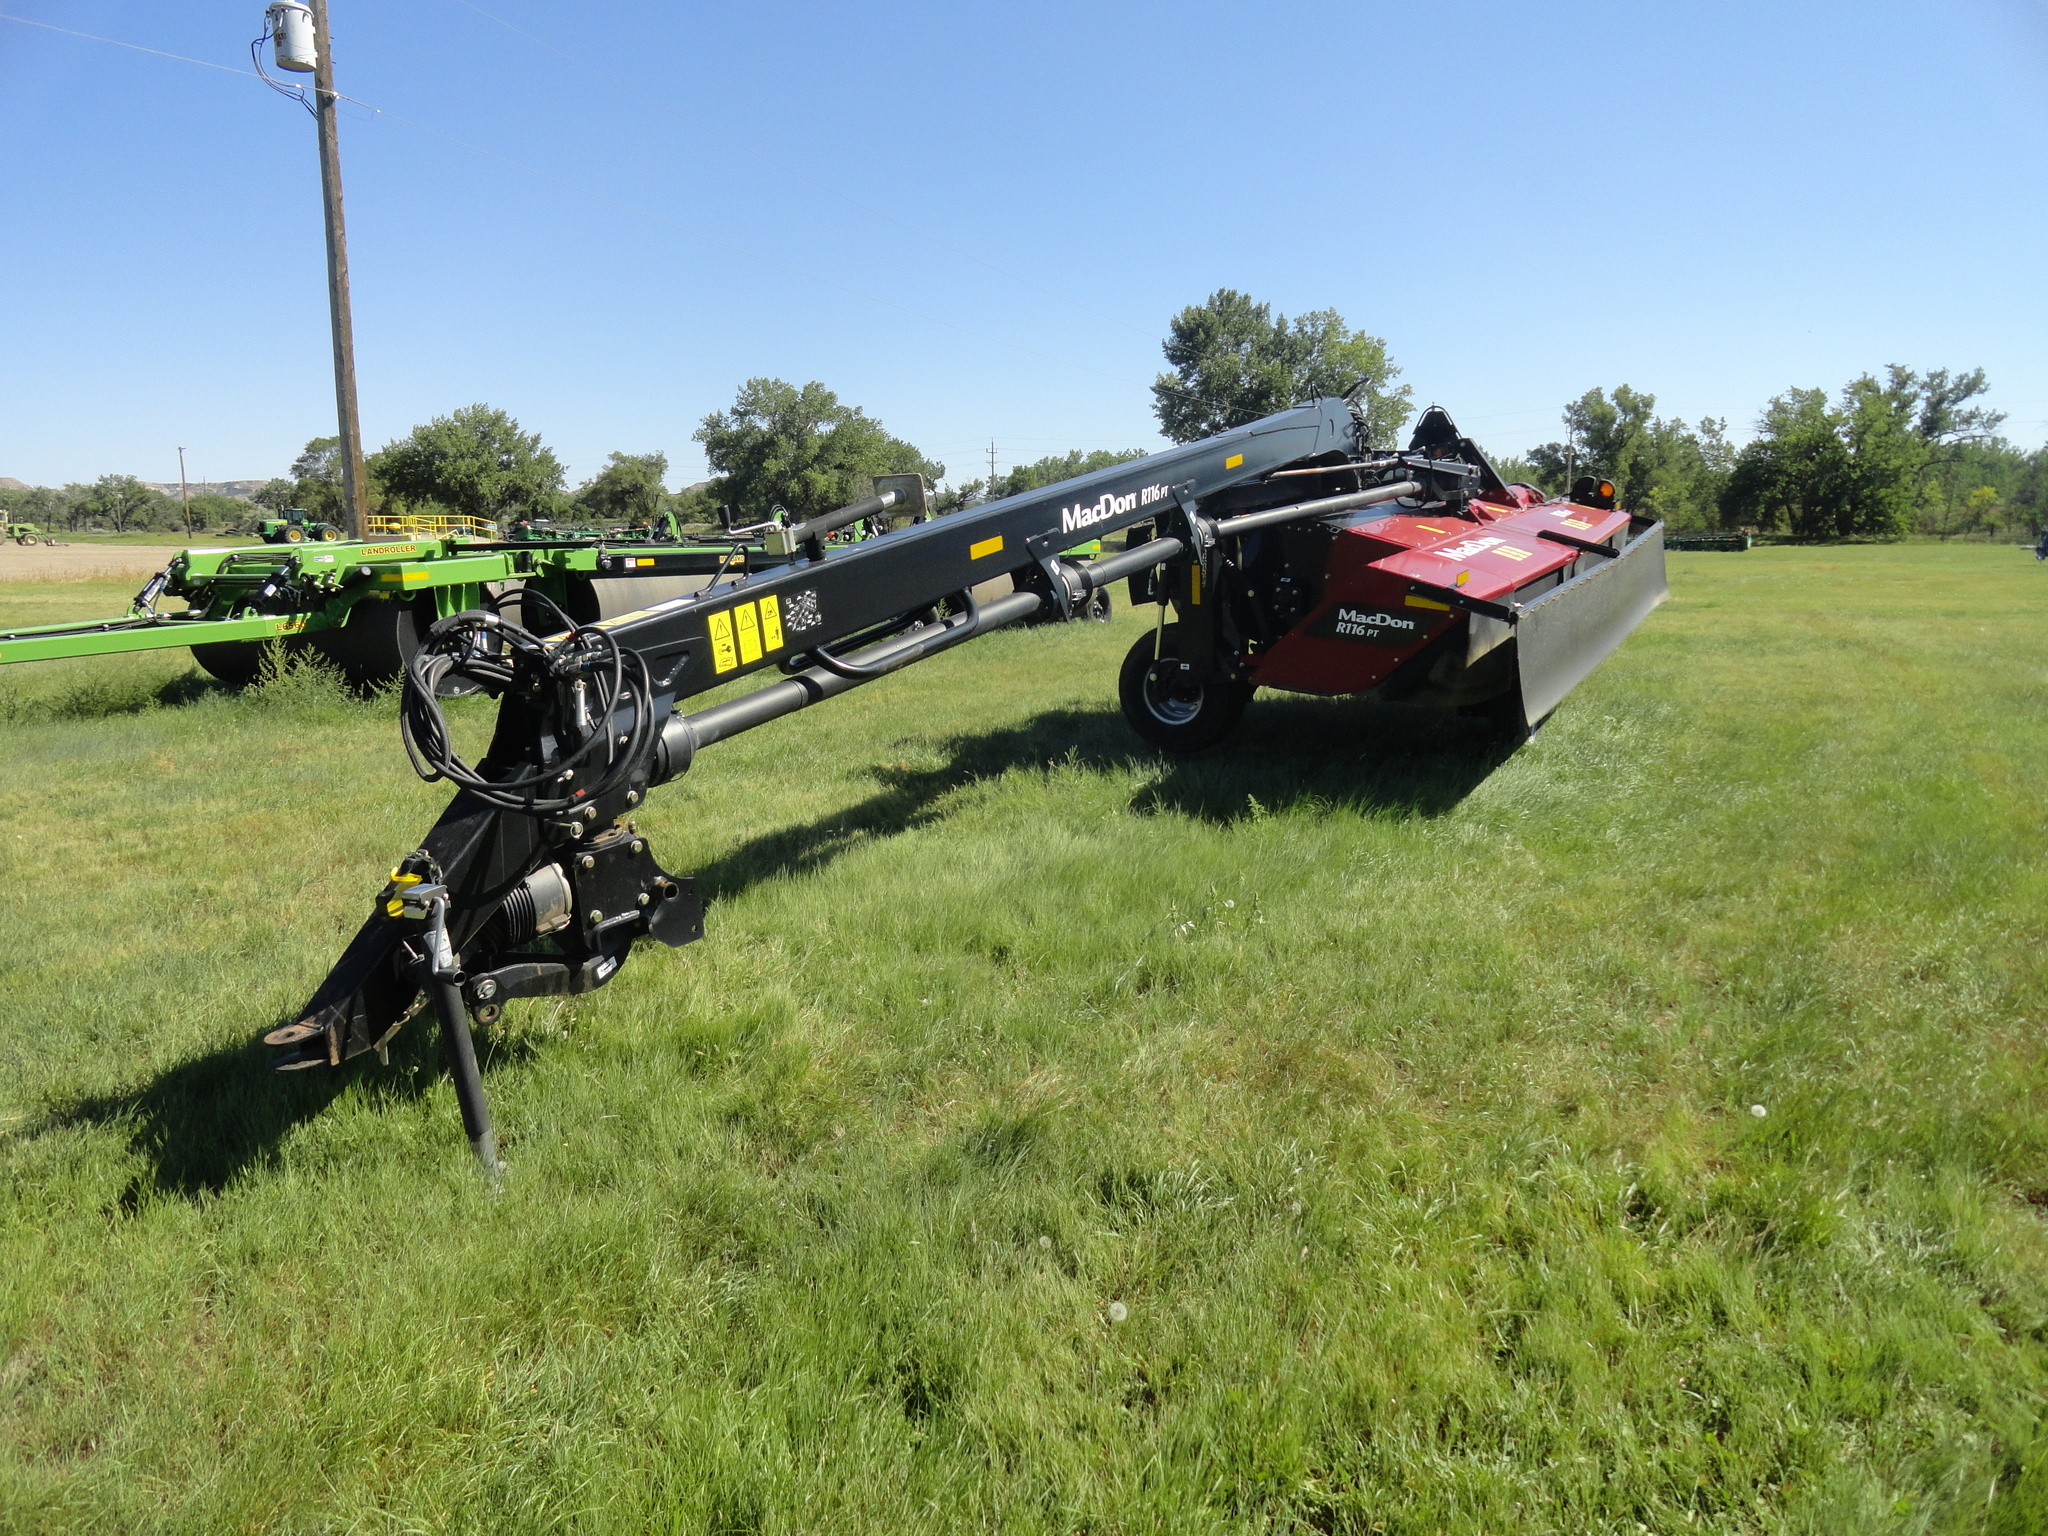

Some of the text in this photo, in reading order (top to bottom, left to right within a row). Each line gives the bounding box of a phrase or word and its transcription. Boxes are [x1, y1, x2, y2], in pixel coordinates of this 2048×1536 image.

[1062, 483, 1169, 534] MacDon R116 PT
[360, 544, 416, 556] LANDROLLER
[1338, 608, 1416, 630] MacDon
[1335, 621, 1380, 638] R116 PT
